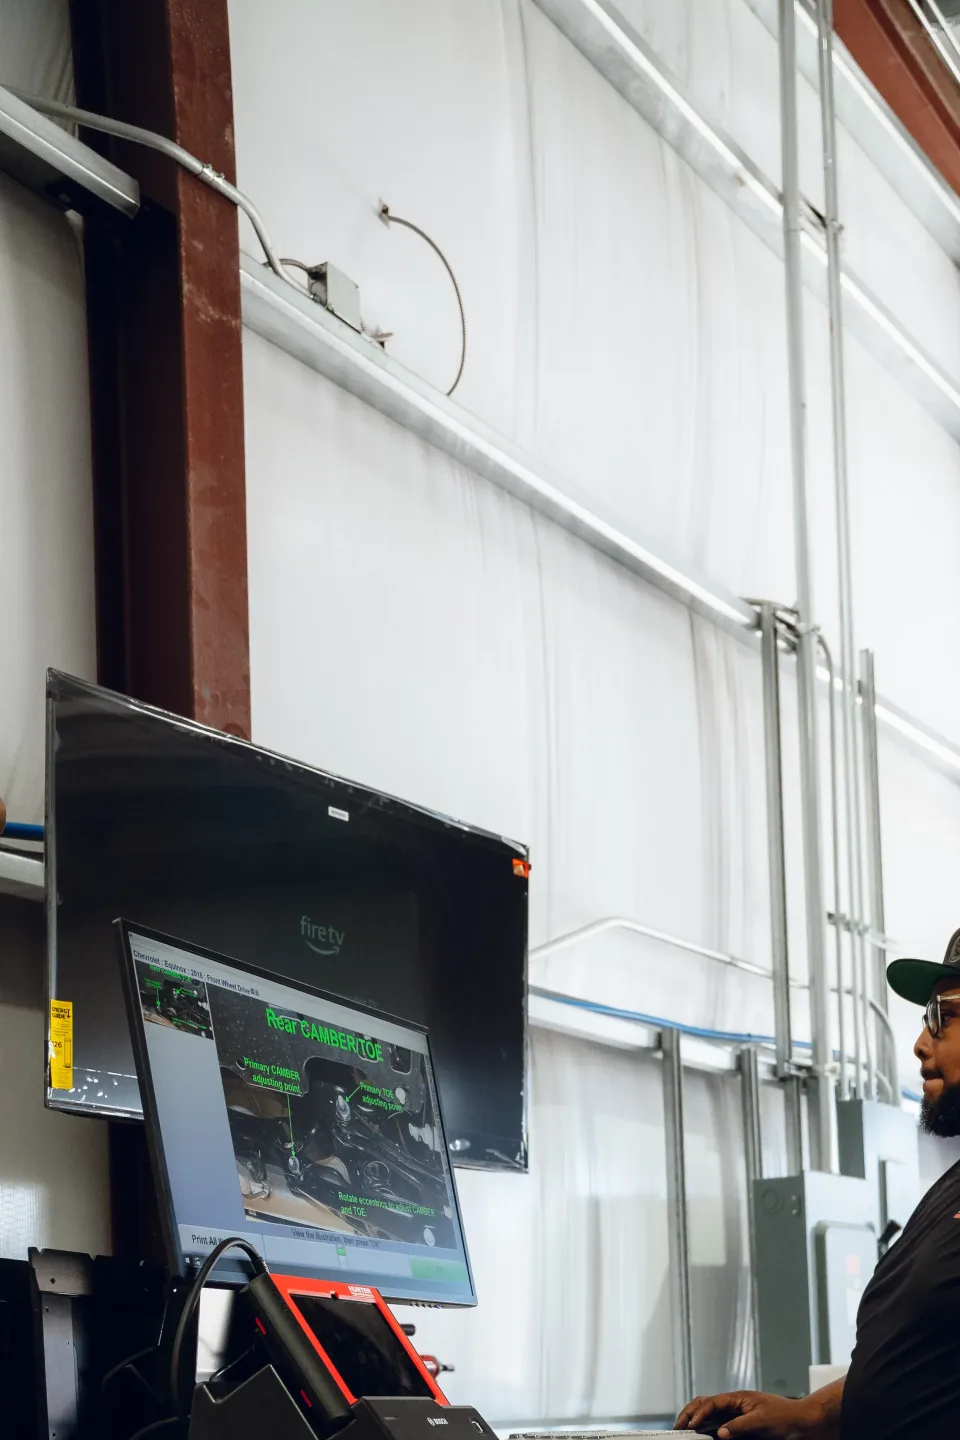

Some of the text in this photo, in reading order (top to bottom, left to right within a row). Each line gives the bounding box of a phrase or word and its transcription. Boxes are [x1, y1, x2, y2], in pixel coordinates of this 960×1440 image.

[133, 950, 161, 966] Chevrolet
[164, 960, 187, 973] Equinox
[207, 974, 221, 985] Front
[221, 979, 237, 991] Wheel
[52, 1007, 70, 1015] ENERGY
[266, 1008, 384, 1062] Rear CAMBER/TOE
[243, 1056, 300, 1080] Primary CAMBER
[253, 1074, 284, 1091] adjusting
[360, 1081, 394, 1099] Primary TOE
[362, 1095, 388, 1110] adjusting
[338, 1191, 358, 1204] Rotate
[359, 1198, 387, 1208] eccentrics
[395, 1203, 412, 1213] adjust
[341, 1206, 352, 1215] and
[191, 1234, 208, 1245] Print
[209, 1236, 218, 1246] All
[292, 1228, 305, 1238] View
[306, 1231, 314, 1239] the
[343, 1236, 354, 1245] then
[347, 1285, 372, 1295] HUNTER
